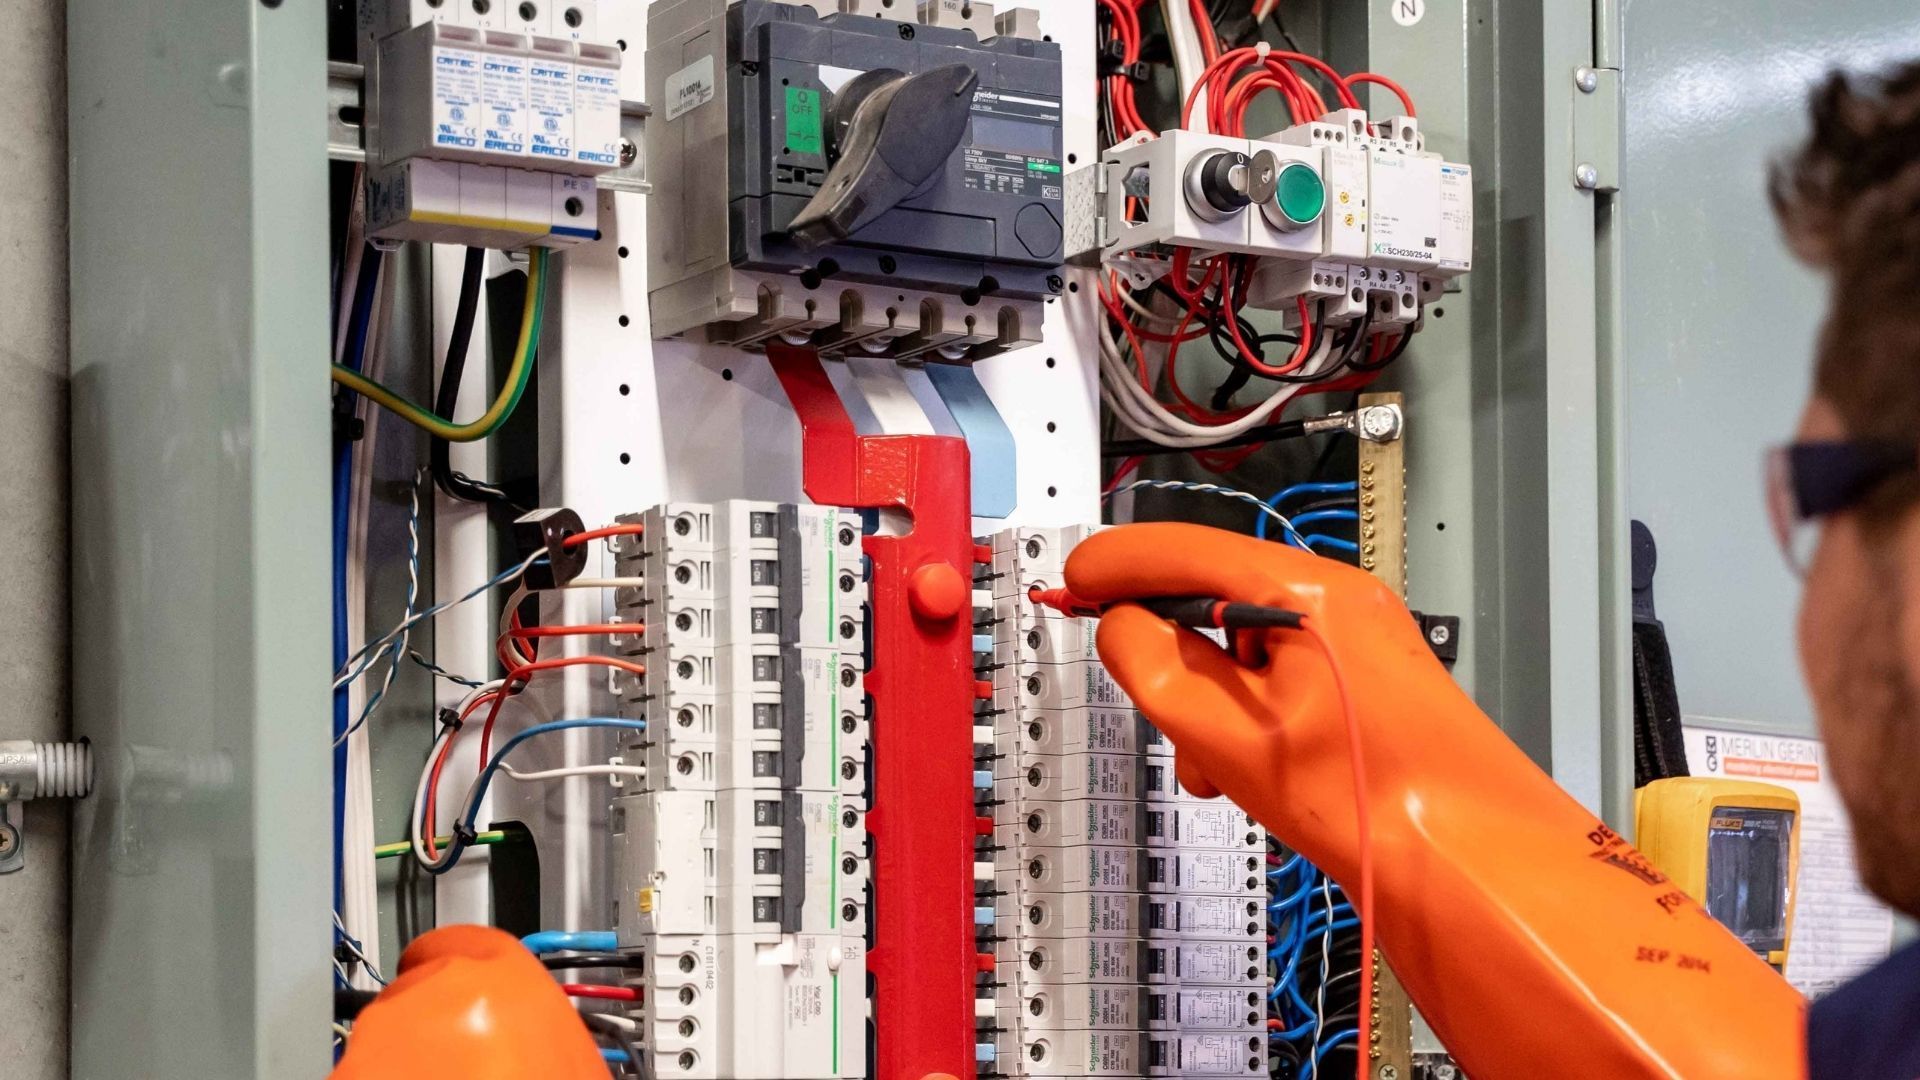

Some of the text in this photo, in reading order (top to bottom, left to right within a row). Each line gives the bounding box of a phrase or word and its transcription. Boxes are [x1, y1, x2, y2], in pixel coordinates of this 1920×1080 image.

[1401, 0, 1416, 18] N
[436, 56, 475, 68] CRITEC
[484, 62, 521, 74] CRITEC
[530, 68, 568, 79] CRITEC
[577, 74, 614, 86] CRITEC
[792, 103, 813, 115] OFF
[437, 134, 476, 147] ERICO
[484, 139, 522, 153] ERICO
[531, 144, 569, 157] ERICO
[577, 151, 615, 164] ERICO
[564, 180, 577, 189] PE
[824, 509, 835, 548] Schneider
[1086, 620, 1096, 657] Schneider
[827, 653, 838, 692] Schneider
[1087, 666, 1096, 703] Schneider
[1088, 712, 1098, 749] Schneider
[1721, 737, 1818, 762] MERLIN GERIN
[1088, 757, 1098, 794] Schneider
[828, 795, 839, 834] Schneider
[1088, 803, 1098, 840] Schneider
[1090, 849, 1099, 886] Schneider
[1090, 895, 1100, 932] Schneider
[1090, 941, 1099, 978] Schneider
[1636, 946, 1669, 962] SEP
[1089, 989, 1099, 1025] Schneider
[1090, 1034, 1099, 1071] Schneider
